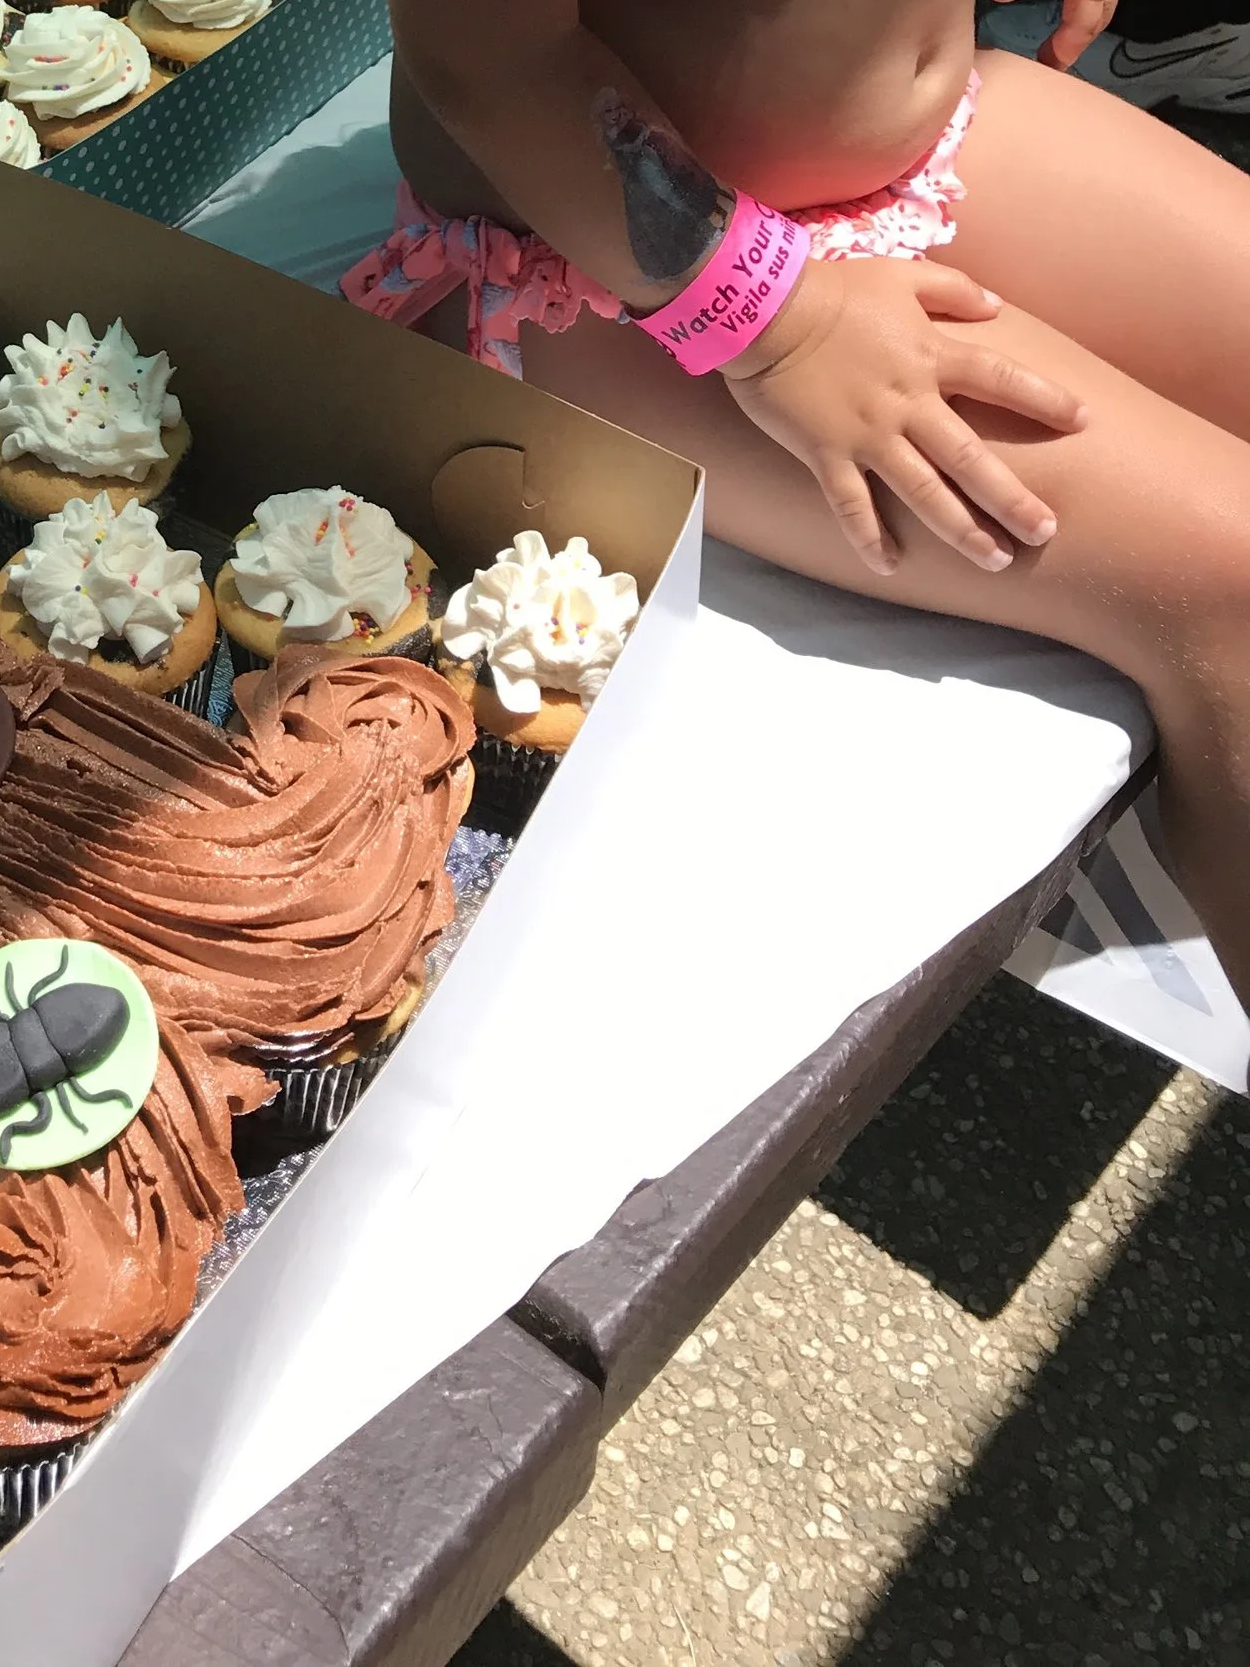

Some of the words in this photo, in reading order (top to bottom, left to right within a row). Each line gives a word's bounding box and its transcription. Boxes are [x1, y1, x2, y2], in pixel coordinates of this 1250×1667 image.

[661, 284, 740, 345] Watch
[732, 220, 773, 279] Your
[719, 280, 772, 333] Vigila
[768, 246, 790, 280] sus
